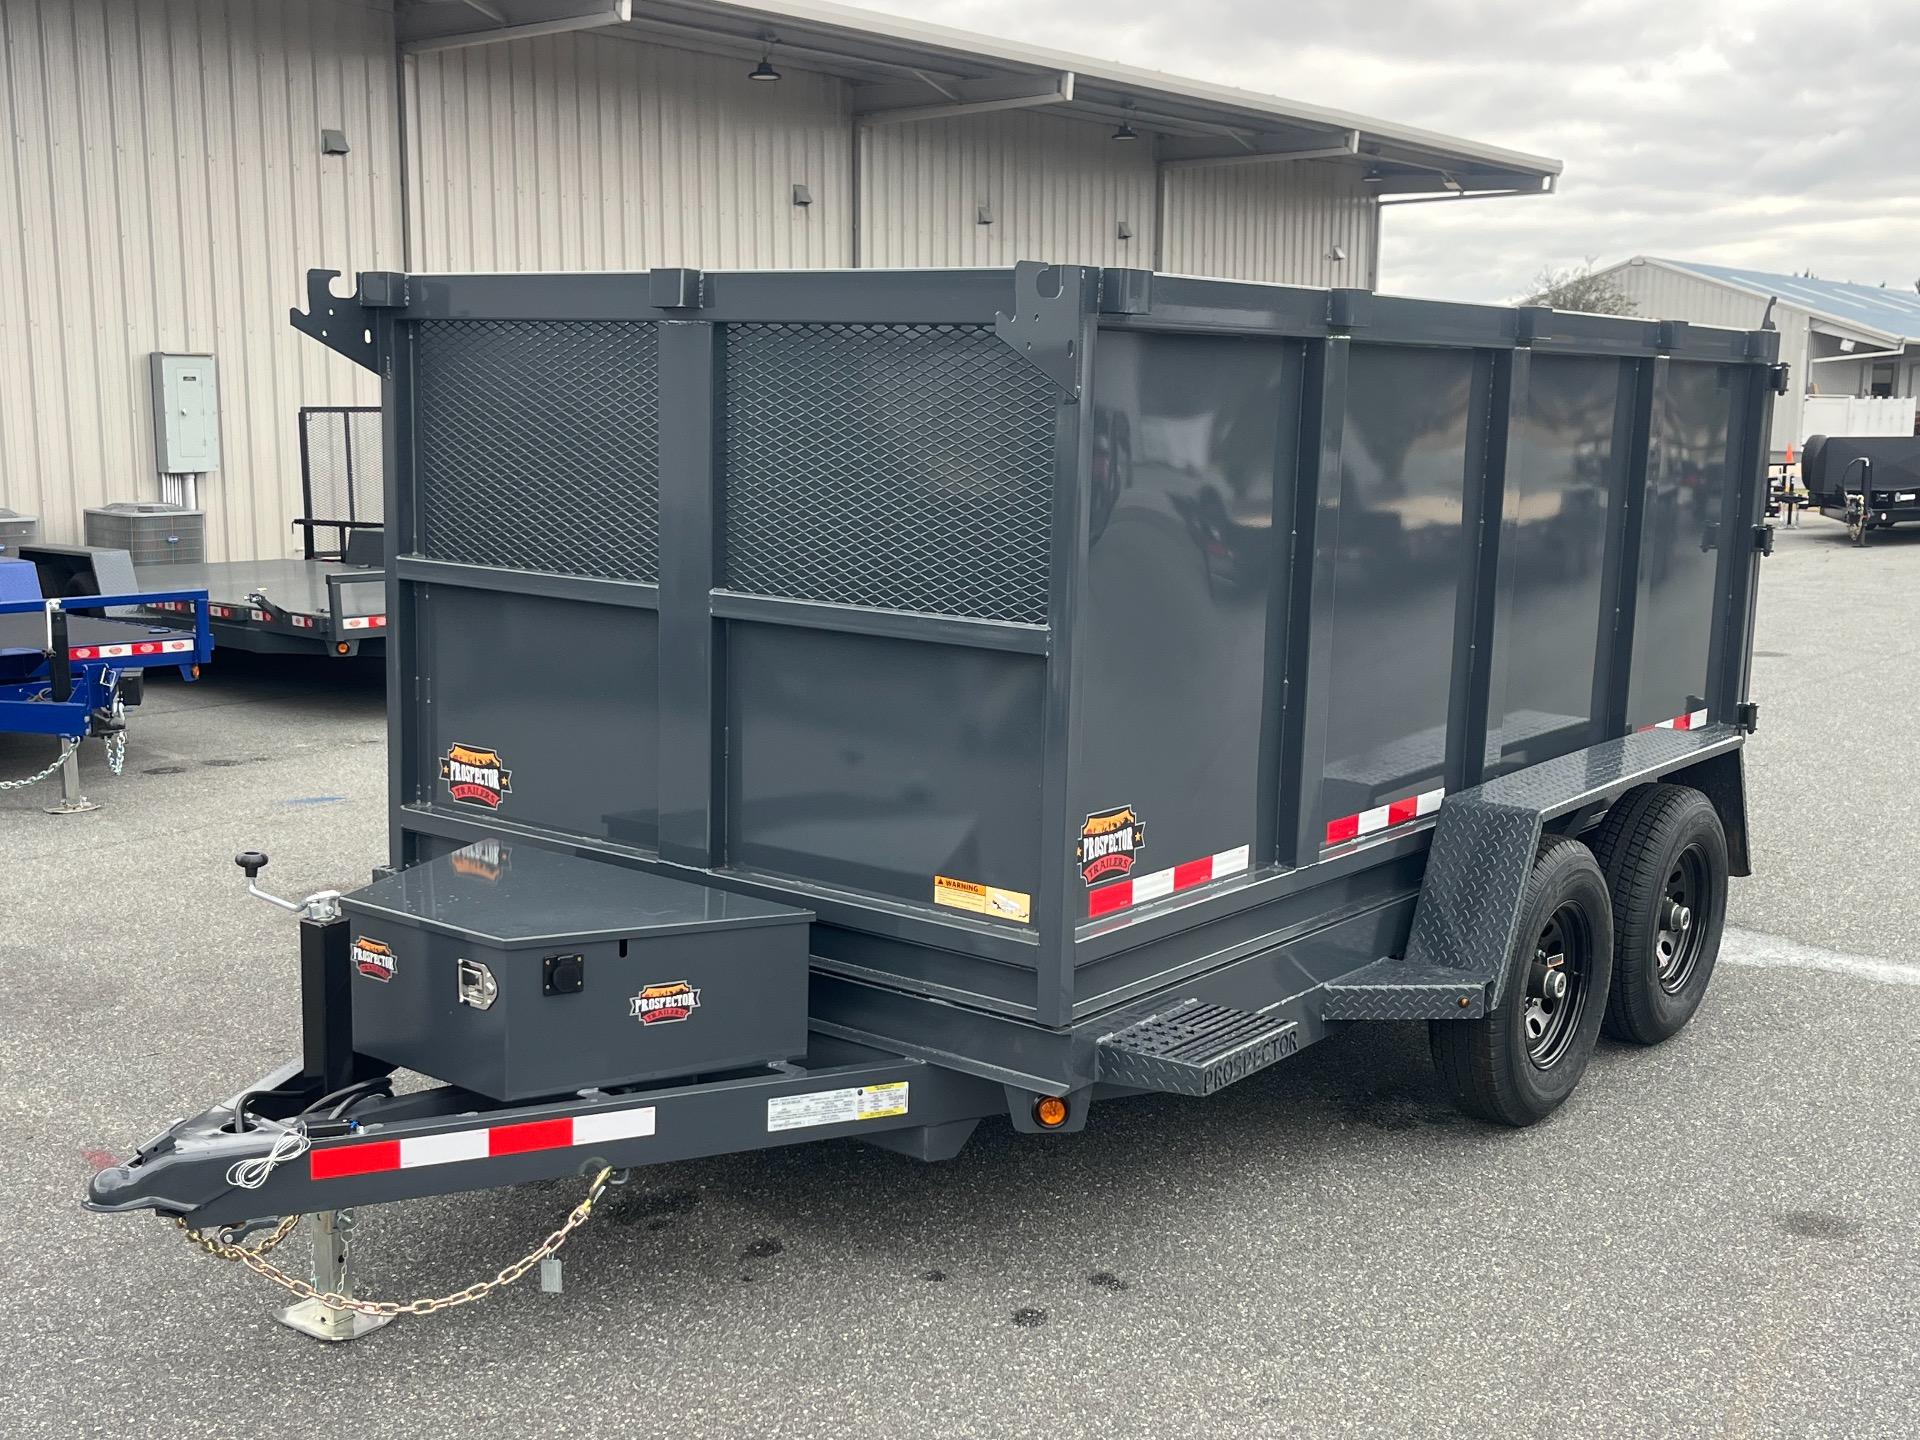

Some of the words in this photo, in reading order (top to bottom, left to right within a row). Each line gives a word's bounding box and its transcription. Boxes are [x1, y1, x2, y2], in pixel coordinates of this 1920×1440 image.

[450, 760, 501, 790] PROSPECTOR
[454, 785, 497, 803] TRAILERS
[1083, 826, 1134, 863] PROSPECTOR
[1088, 856, 1130, 878] TRAILERS
[945, 880, 979, 893] WARNING
[634, 992, 696, 1013] PROSPECTOR
[1203, 1029, 1298, 1094] PROSPECTOR
